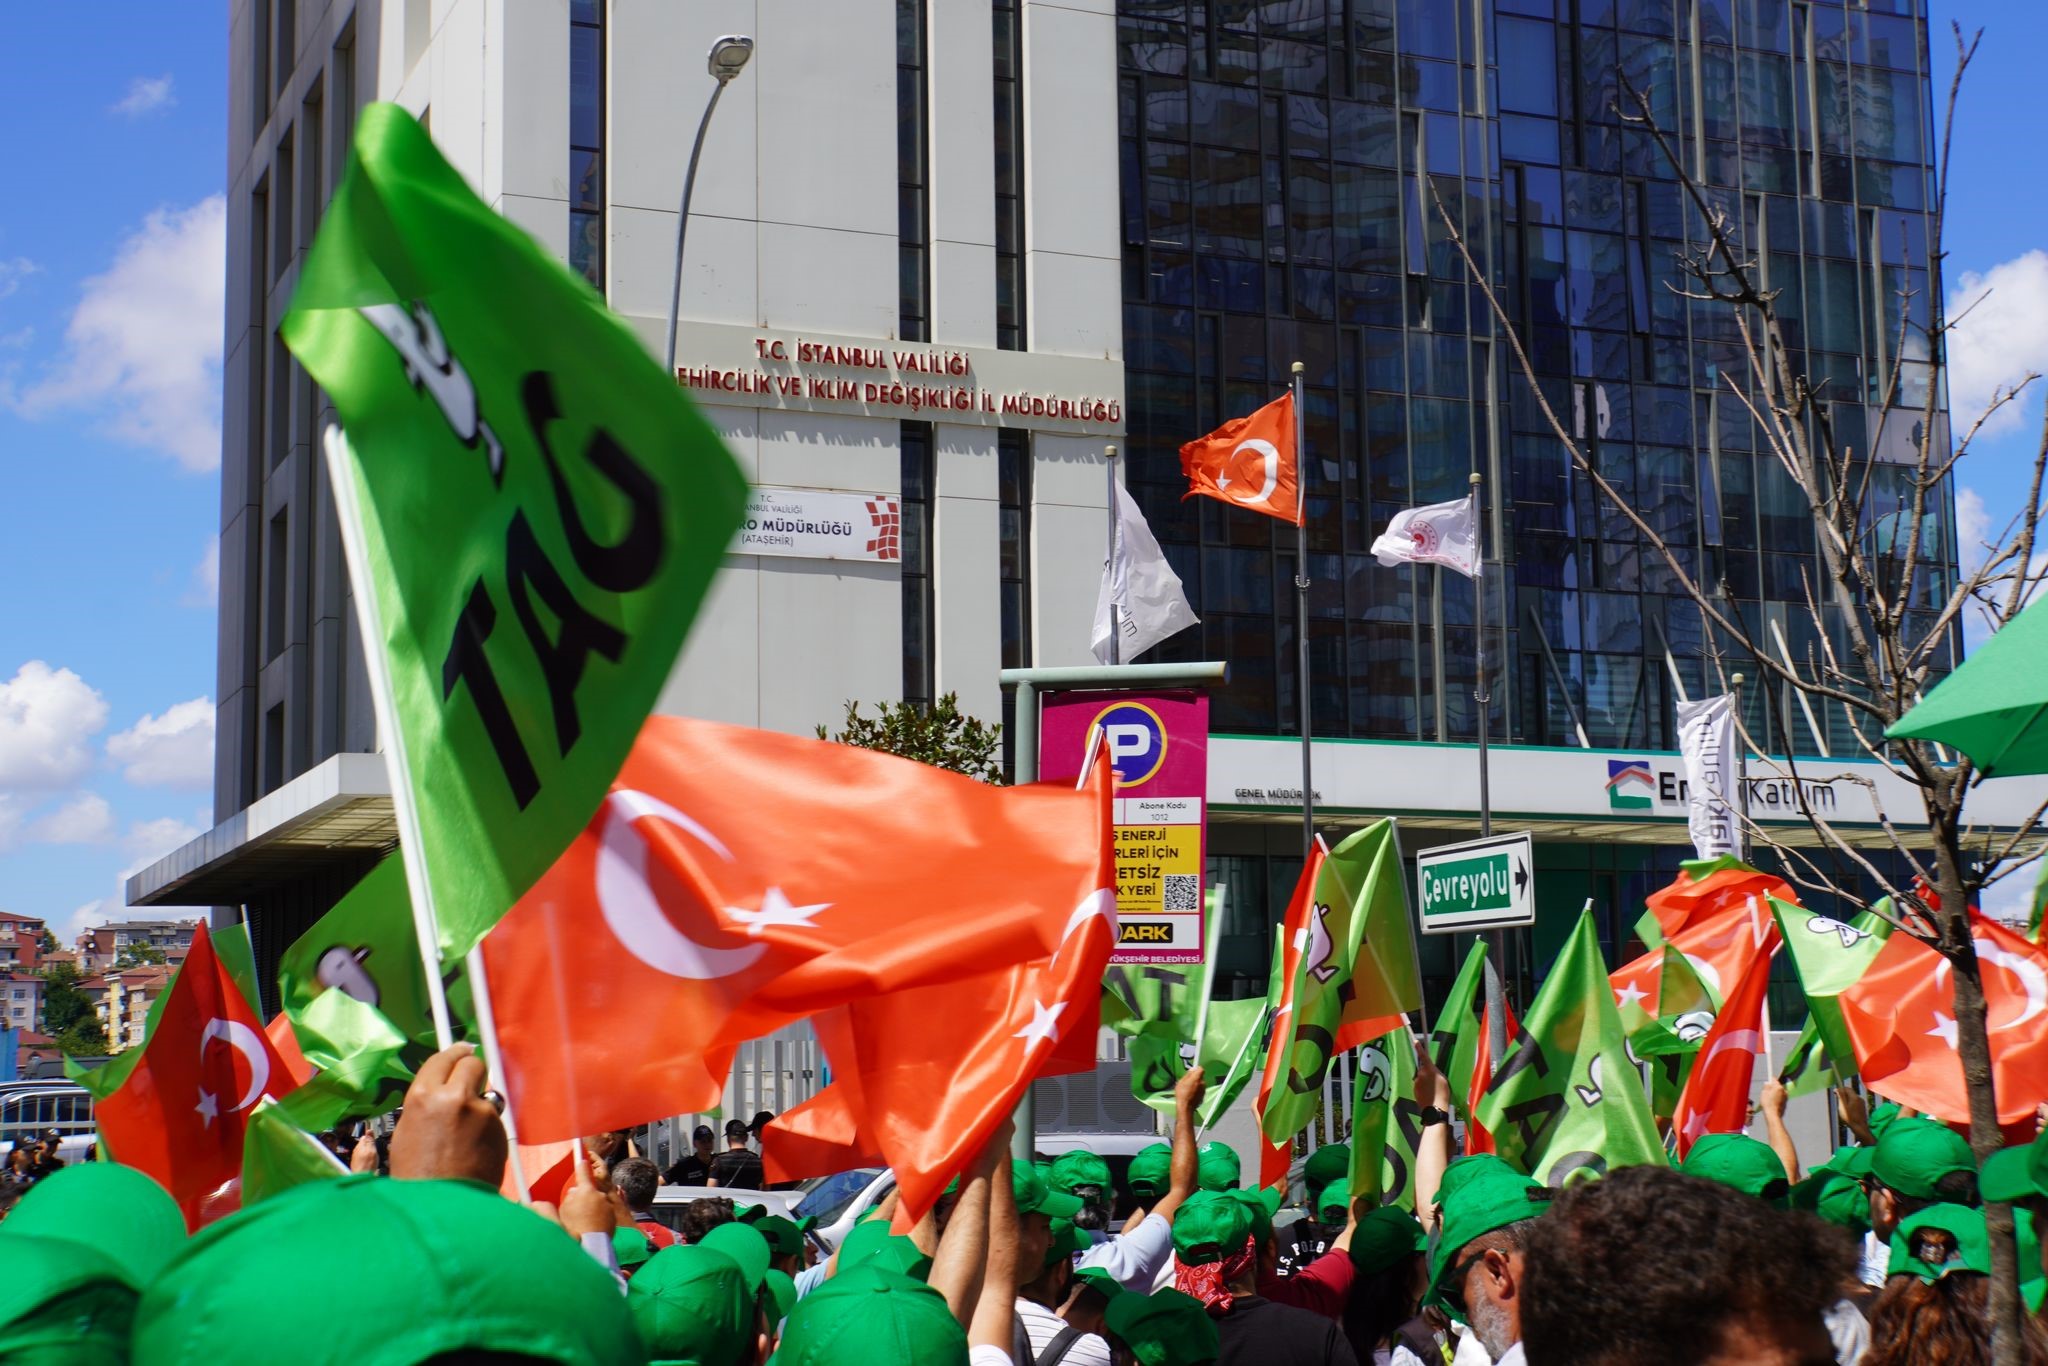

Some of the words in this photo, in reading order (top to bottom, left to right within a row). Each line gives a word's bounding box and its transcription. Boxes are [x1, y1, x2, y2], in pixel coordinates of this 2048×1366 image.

[756, 339, 789, 361] T.C.
[797, 338, 888, 369] İSTANBUL
[893, 350, 969, 376] VALİLİĞİ
[675, 364, 772, 394] EHİRCİLİK
[777, 376, 801, 396] VE
[808, 373, 859, 401] İKLİM
[866, 380, 974, 412] DEĞİŞİKLİĞİ
[981, 388, 996, 413] İL
[1002, 391, 1120, 423] MÜDÜRLÜĞÜ
[745, 505, 769, 513] ANBUL
[762, 518, 852, 536] MÜDÜRLÜĞÜ
[741, 534, 794, 547] (ATAŞEHİR)
[1106, 723, 1151, 765] P
[1235, 788, 1265, 798] GENEL
[1151, 813, 1168, 821] 1012
[1122, 828, 1166, 841] ENERJİ
[1114, 845, 1149, 858] RLERİ
[1152, 845, 1179, 860] İÇİN
[1115, 863, 1161, 879] ETSİZ
[1116, 885, 1125, 896] K
[1127, 882, 1156, 896] YERİ
[1423, 860, 1508, 909] Çevreyolu
[1122, 926, 1169, 940] ARK
[1151, 954, 1200, 963] BELEDİYESİ
[1276, 1255, 1294, 1277] U.S.
[1291, 1240, 1326, 1256] POLO
